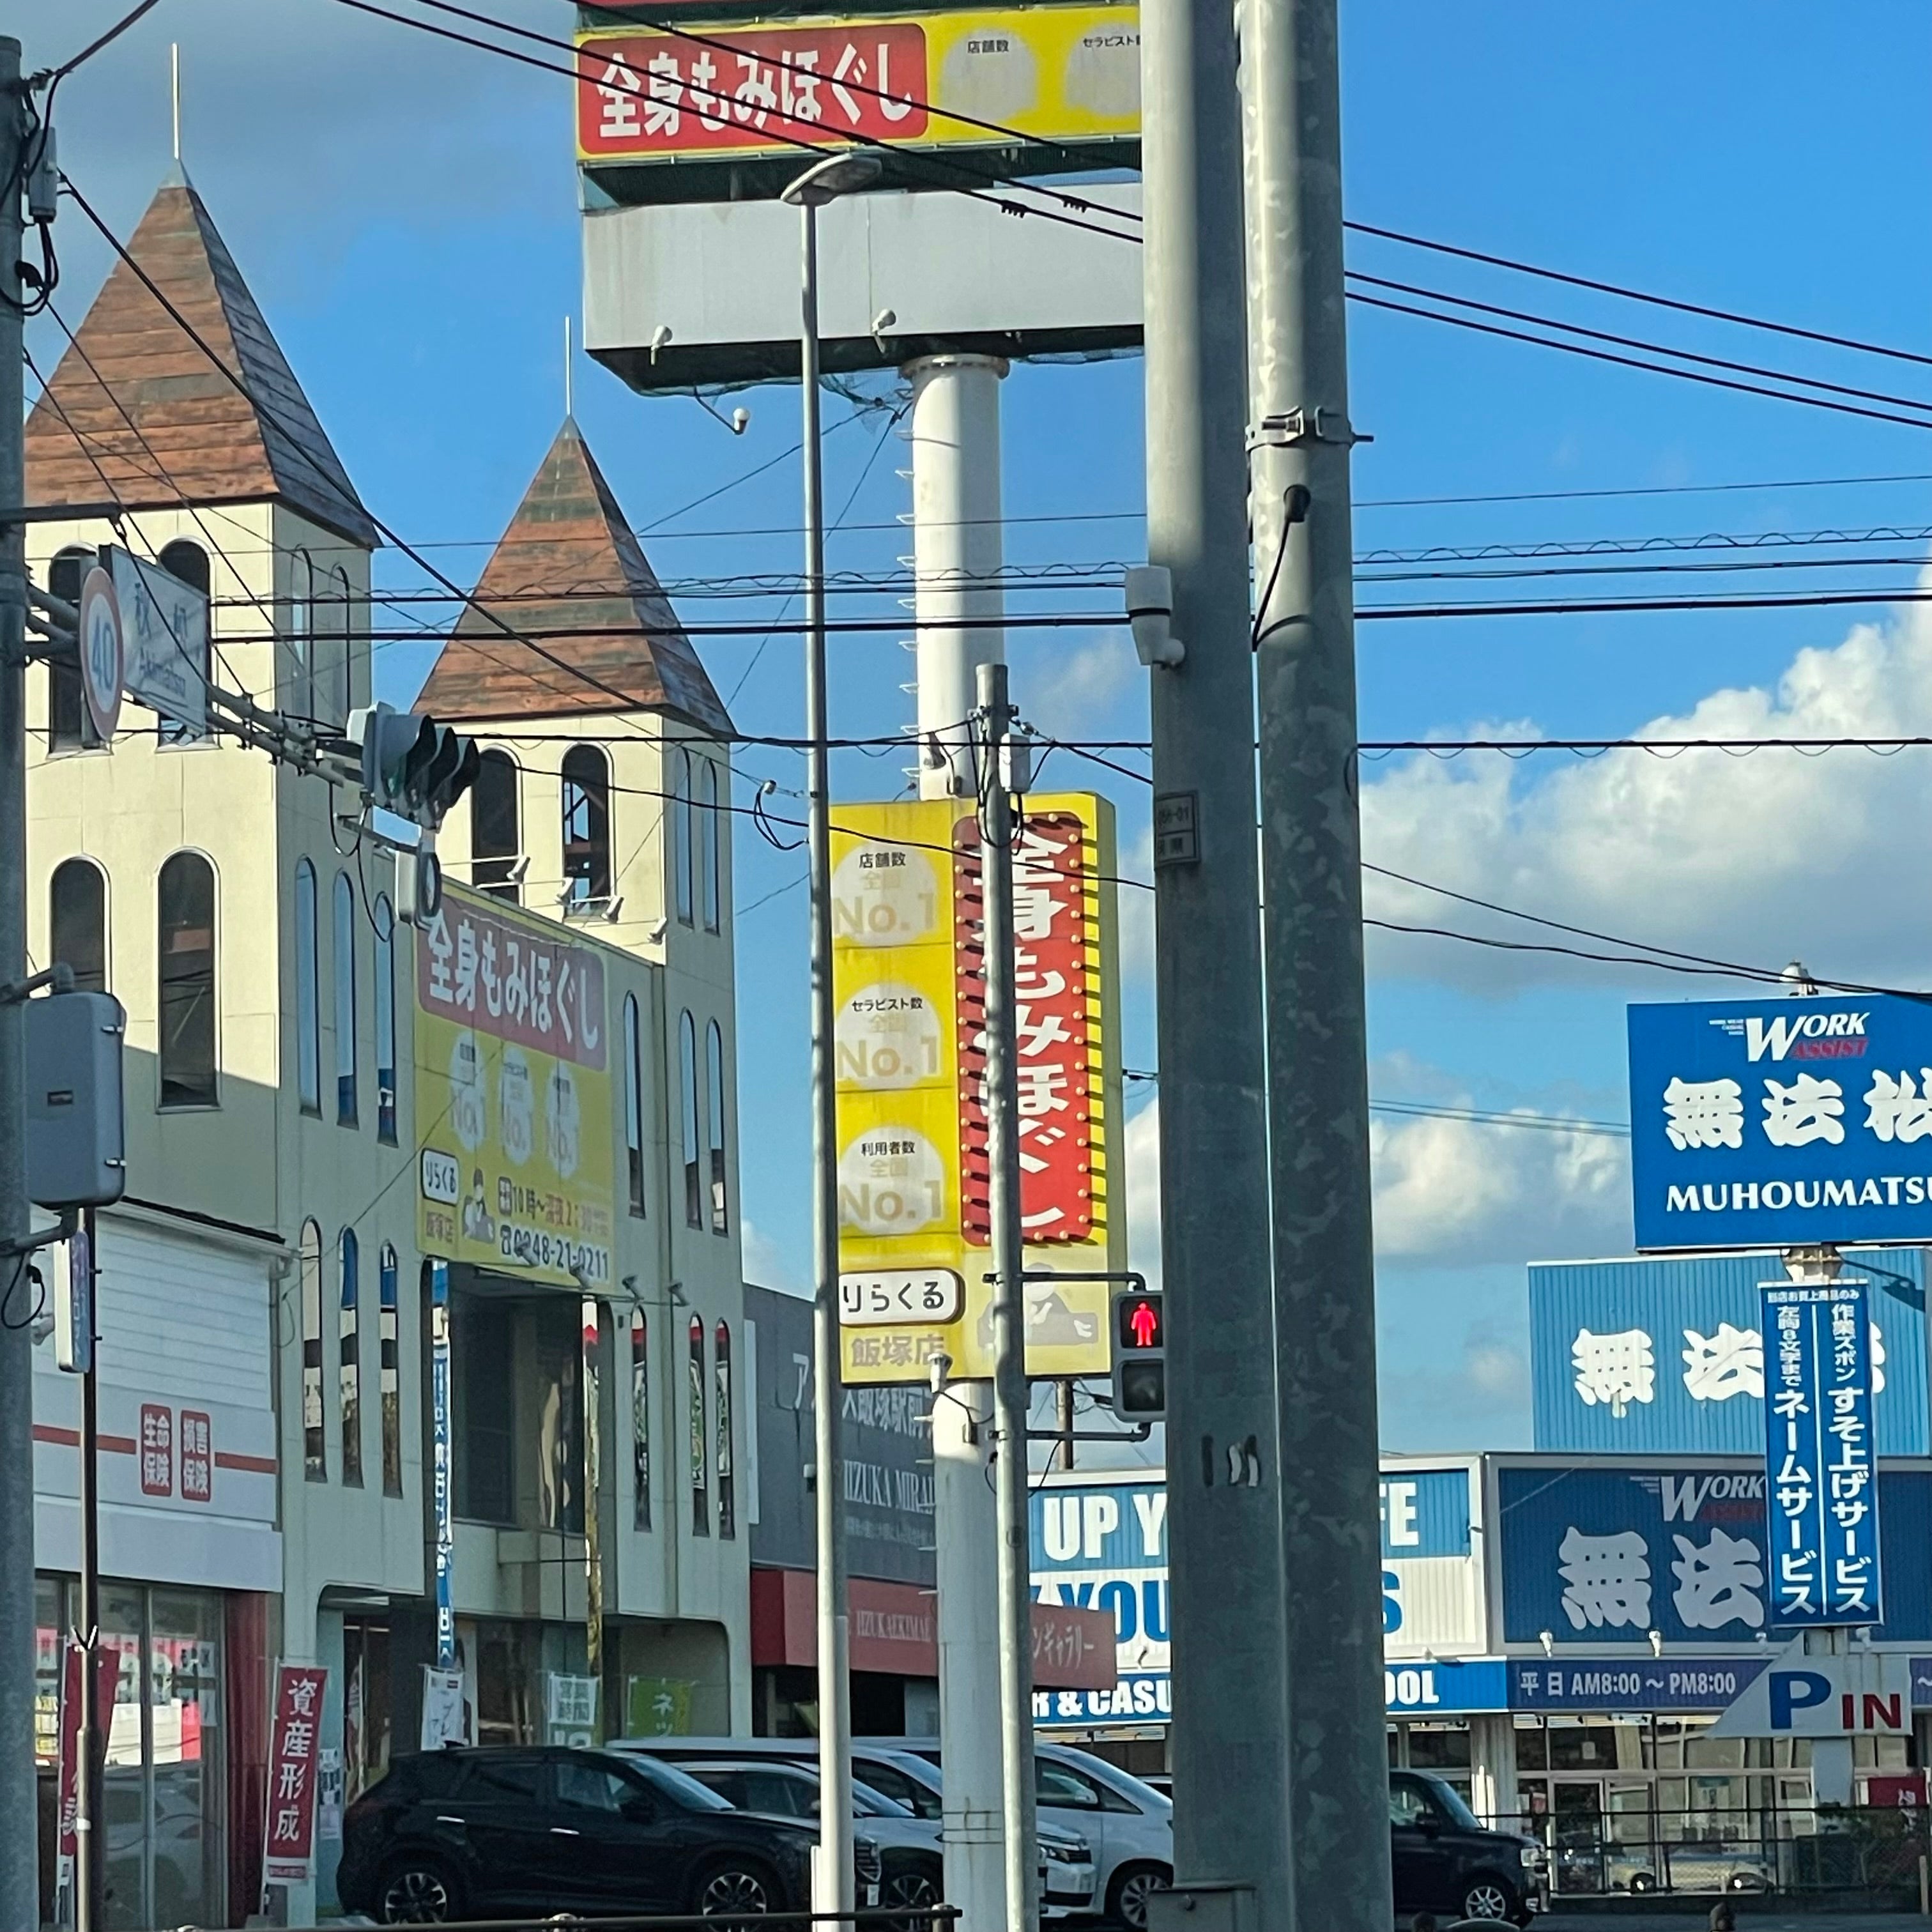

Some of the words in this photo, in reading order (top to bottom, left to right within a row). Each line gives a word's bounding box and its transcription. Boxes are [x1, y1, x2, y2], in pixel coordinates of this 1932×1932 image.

[597, 43, 912, 137] 全身もみほぐし
[91, 613, 114, 692] 40
[859, 852, 906, 868] 店舗数
[428, 908, 599, 1050] 全身もみほぐし
[1746, 1012, 1870, 1062] WORK
[1791, 1038, 1868, 1060] ASSIST
[1663, 1068, 1932, 1151] 無法松
[426, 1161, 456, 1194] りらくる
[861, 1141, 916, 1156] 利用者数
[843, 1281, 944, 1313] りらくる
[851, 1334, 945, 1367] 飯塚店
[1572, 1322, 1885, 1406] 無法
[843, 1459, 892, 1508] IIZUKA
[1660, 1475, 1766, 1522] WORK
[1773, 1388, 1818, 1615] ネームサービス
[1827, 1386, 1872, 1613] すそ上げサービス
[1043, 1495, 1119, 1562] UP
[1558, 1526, 1765, 1630] 無法
[1520, 1671, 1563, 1696] 平日
[1769, 1671, 1832, 1730] P
[1842, 1693, 1902, 1729] IN
[274, 1678, 318, 1842] 資産形成
